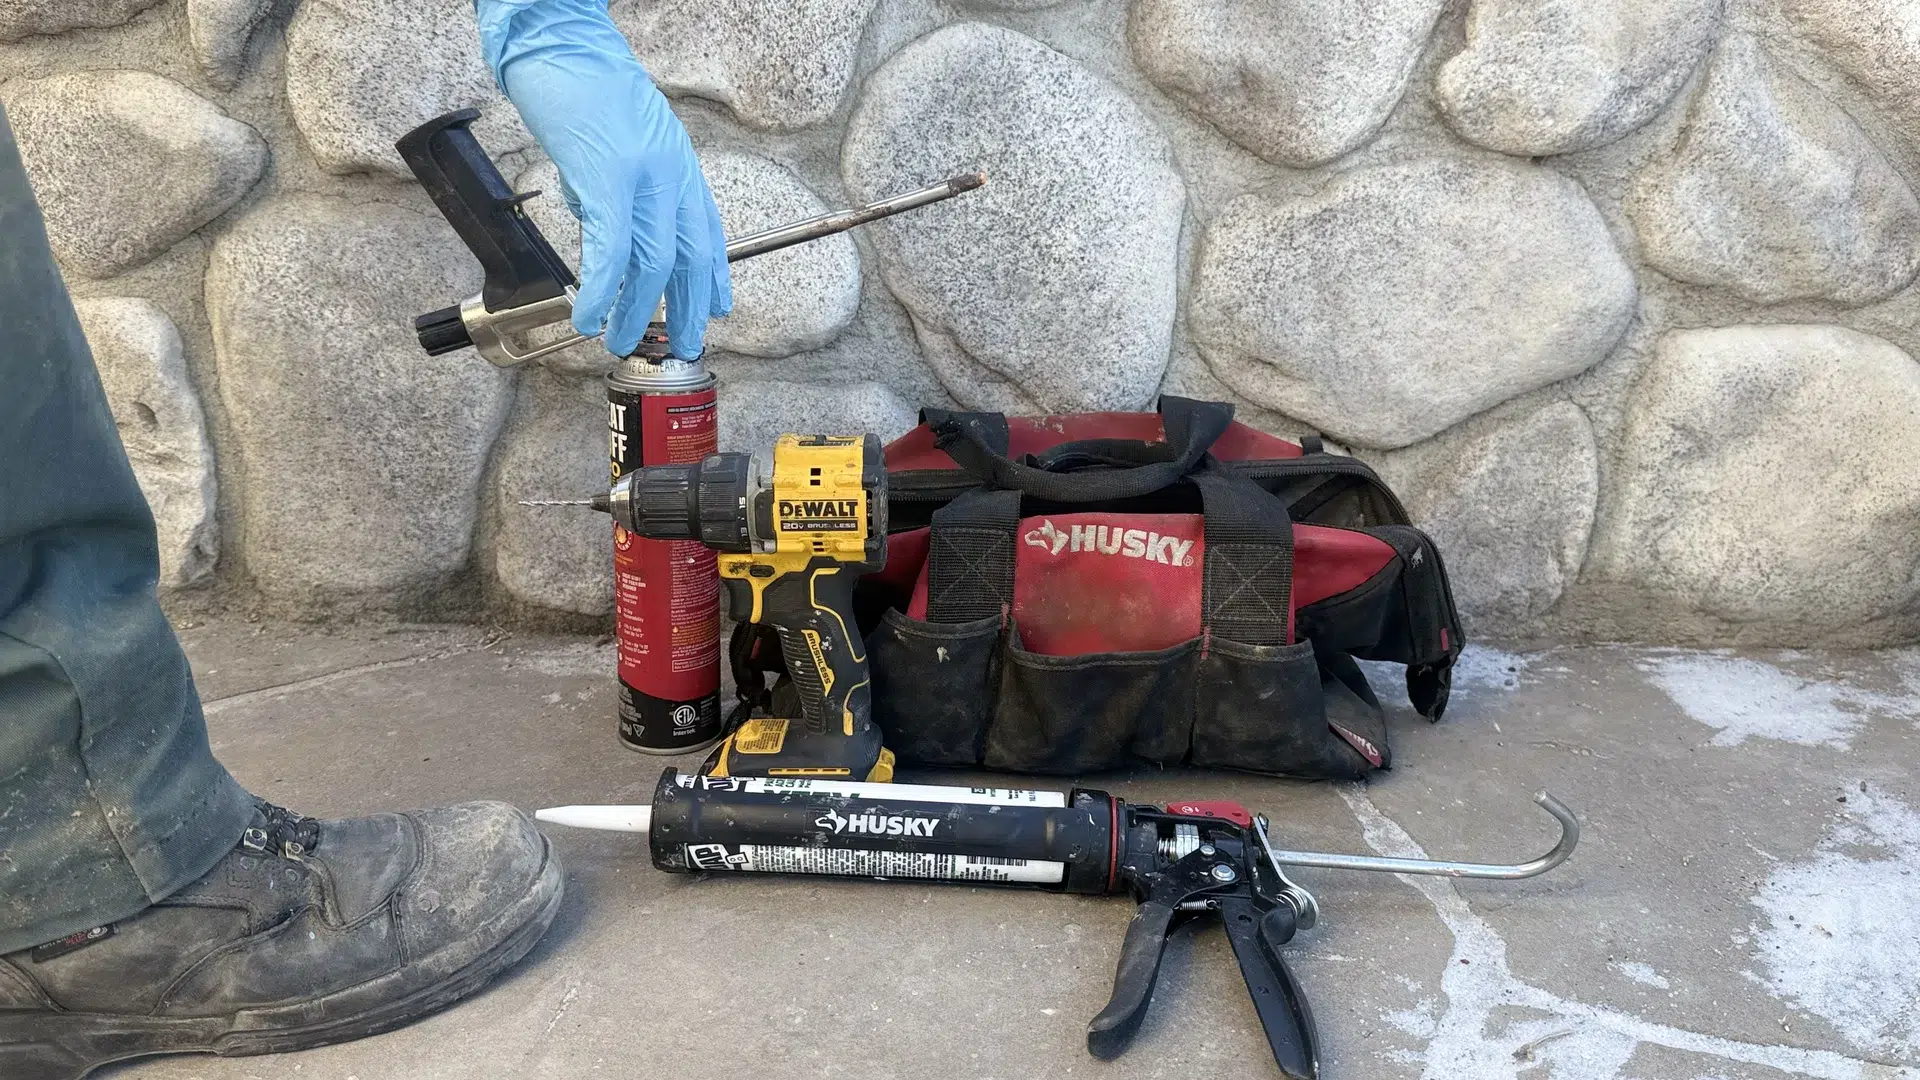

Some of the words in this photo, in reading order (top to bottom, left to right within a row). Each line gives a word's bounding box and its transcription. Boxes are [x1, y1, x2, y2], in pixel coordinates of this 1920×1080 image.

[638, 360, 676, 374] EYEWEAR
[608, 401, 627, 432] AT
[739, 497, 746, 509] 15
[780, 501, 858, 517] DEWALT
[741, 527, 748, 537] 13
[1070, 524, 1194, 566] HUSKY
[807, 632, 831, 684] BRUSHLESS
[672, 727, 696, 736] Intertek
[848, 814, 940, 837] HUSKY
